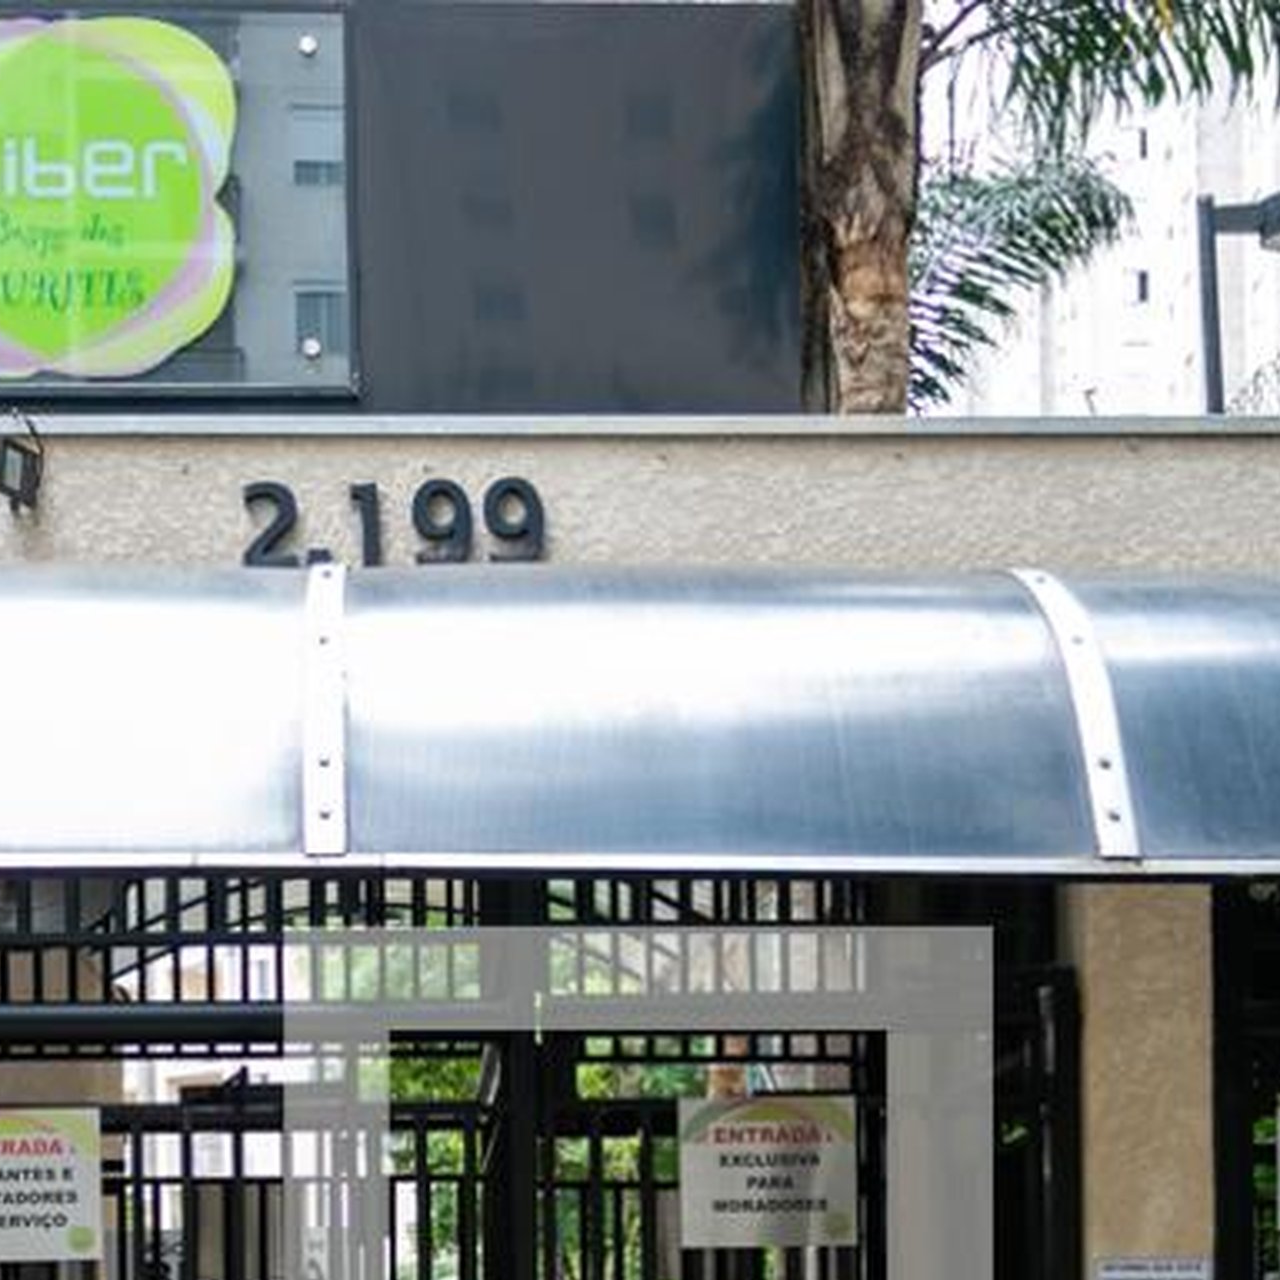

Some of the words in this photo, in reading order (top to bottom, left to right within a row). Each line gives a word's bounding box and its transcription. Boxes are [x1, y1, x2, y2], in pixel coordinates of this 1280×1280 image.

[719, 1153, 821, 1167] EXCLUSIVA
[62, 1168, 73, 1182] E
[746, 1176, 794, 1189] PARA
